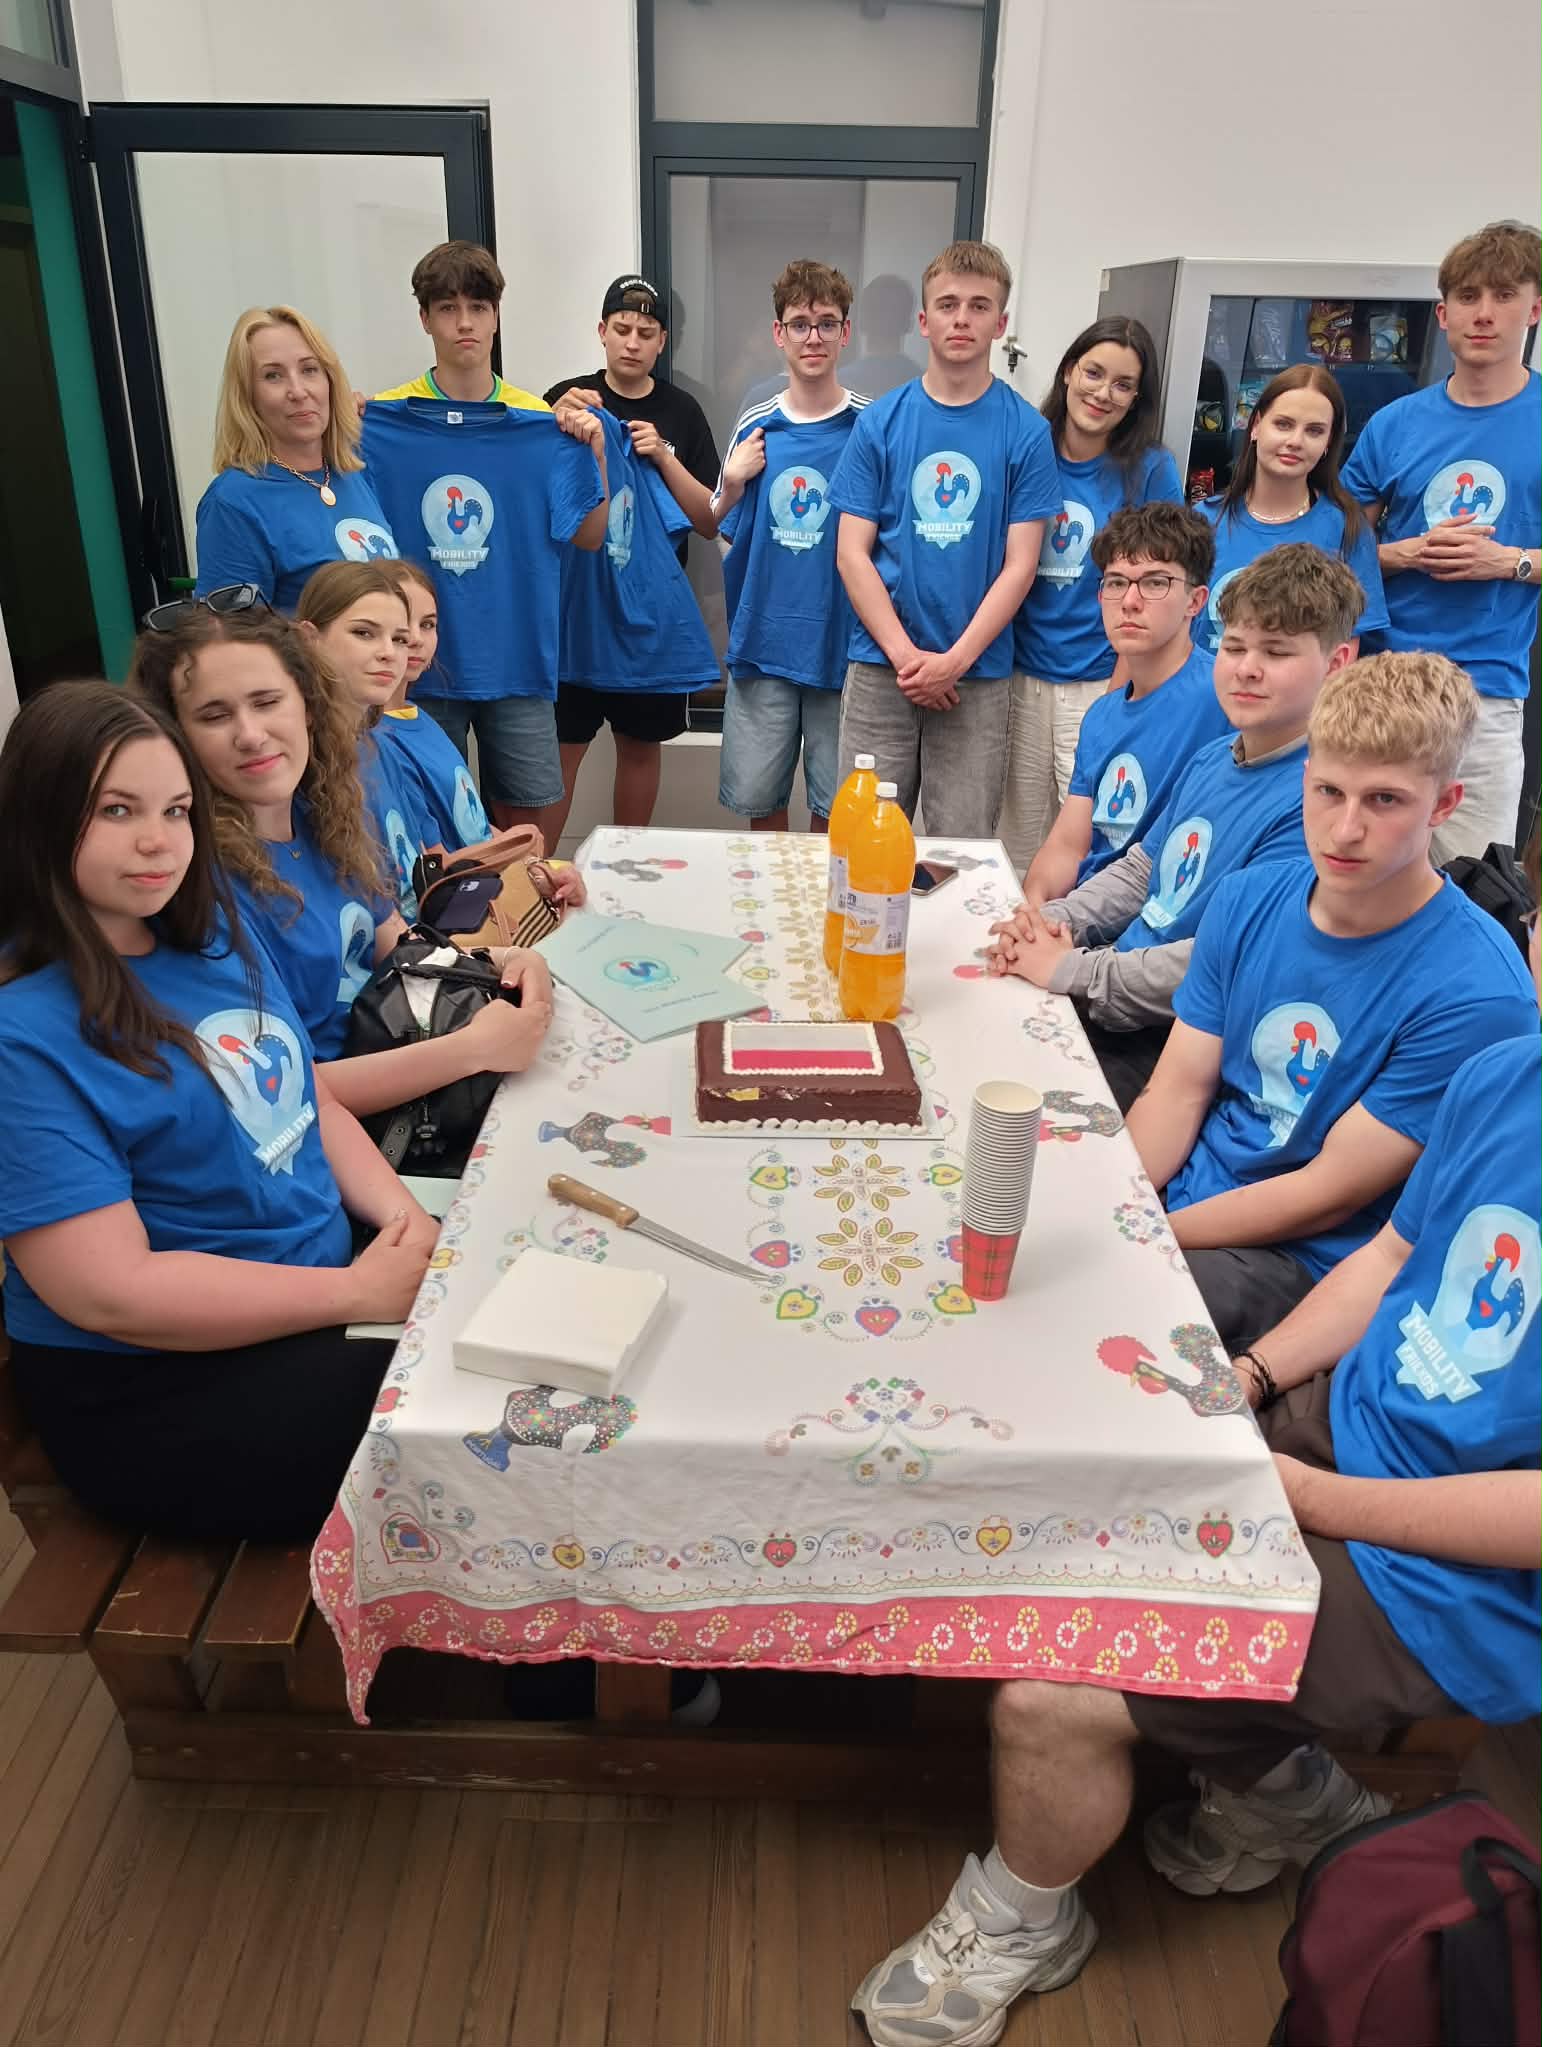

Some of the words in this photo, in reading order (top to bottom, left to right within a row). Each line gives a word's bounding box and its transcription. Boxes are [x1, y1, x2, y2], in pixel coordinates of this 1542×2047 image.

[918, 521, 972, 532] MOBILITY
[773, 527, 821, 544] MOBILITY
[431, 549, 487, 560] MOBILITY
[262, 1109, 315, 1166] MOBILITY
[1405, 1314, 1471, 1396] MOBILITY
